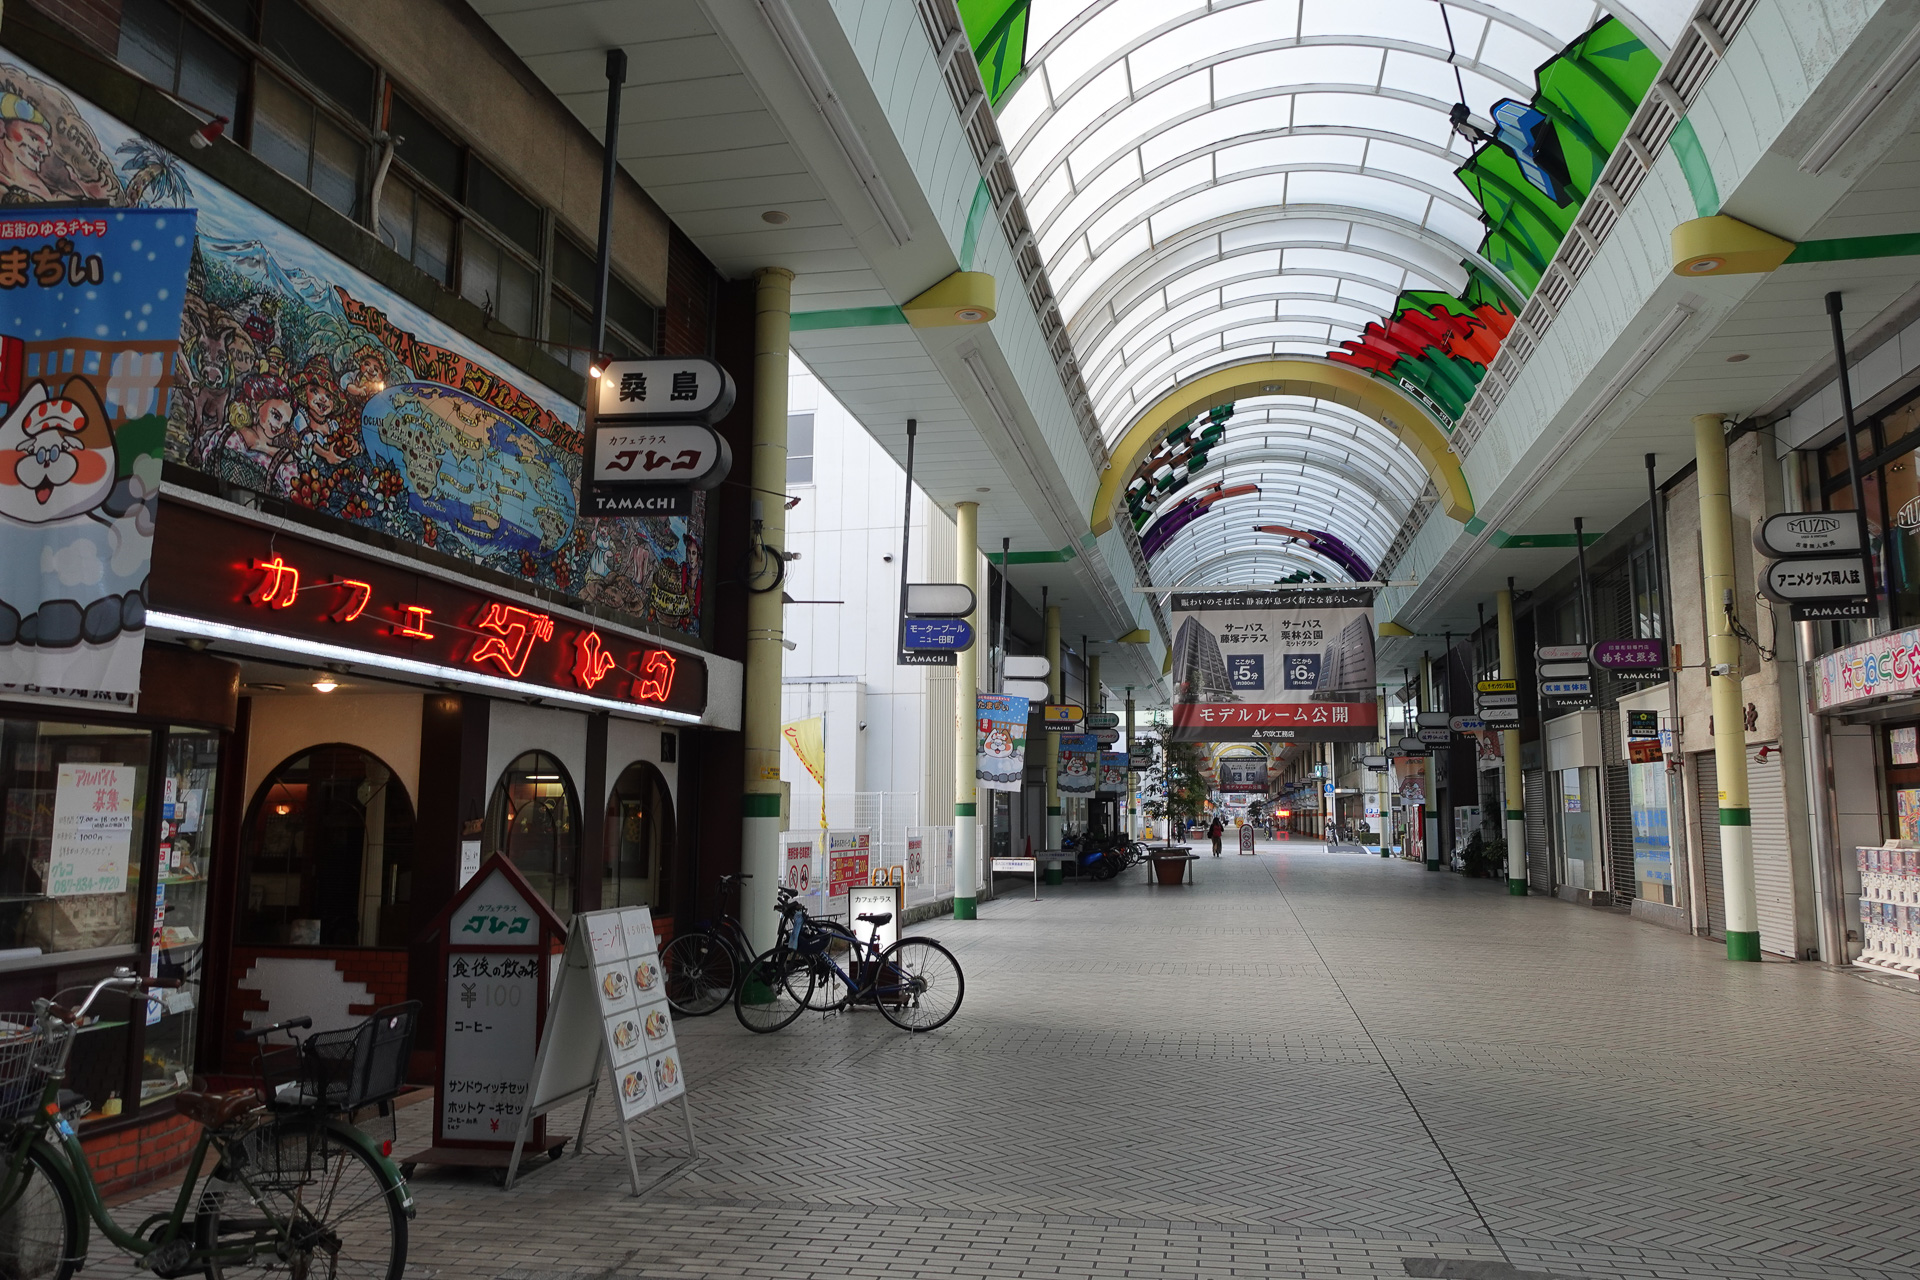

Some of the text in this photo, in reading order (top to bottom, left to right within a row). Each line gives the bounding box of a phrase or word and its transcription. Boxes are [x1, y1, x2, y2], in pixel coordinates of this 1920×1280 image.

[0, 221, 108, 238] 店街のゆるキャラ
[619, 371, 699, 402] 桑島
[461, 363, 541, 427] グレコ
[609, 435, 667, 446] カフェテラス
[605, 450, 702, 472] グレコ
[596, 498, 676, 509] TAMACHI
[1899, 499, 1920, 525] MU
[1790, 519, 1836, 532] MUZIN
[1777, 570, 1860, 587] アニメグッズ同人誌
[1181, 595, 1363, 607] 賑わいのそばに、静寂が息づく新たな暮らしへ。
[1803, 606, 1866, 617] TAMACHI
[250, 555, 677, 702] カフェ グレコ
[910, 624, 965, 633] モータープール
[1281, 630, 1323, 640] 栗林公園
[919, 635, 955, 644] ニュー田町
[1219, 634, 1269, 644] 藤塚テラス
[1239, 666, 1258, 681] 5分
[1295, 665, 1316, 680] 6分
[1851, 648, 1911, 690] こねくと
[1563, 683, 1588, 691] 整体院
[977, 701, 1009, 711] たまぢい
[1199, 706, 1350, 724] モデルルーム公開
[75, 768, 117, 787] アルバイト
[92, 788, 119, 812] 募集
[51, 861, 74, 877] グレコ
[855, 895, 892, 904] カフェテラス
[477, 904, 518, 913] カフェテラス
[462, 915, 531, 935] グレコ
[452, 957, 539, 978] 食後の飲み物
[484, 984, 522, 1008] 100
[454, 1021, 493, 1032] コーヒー
